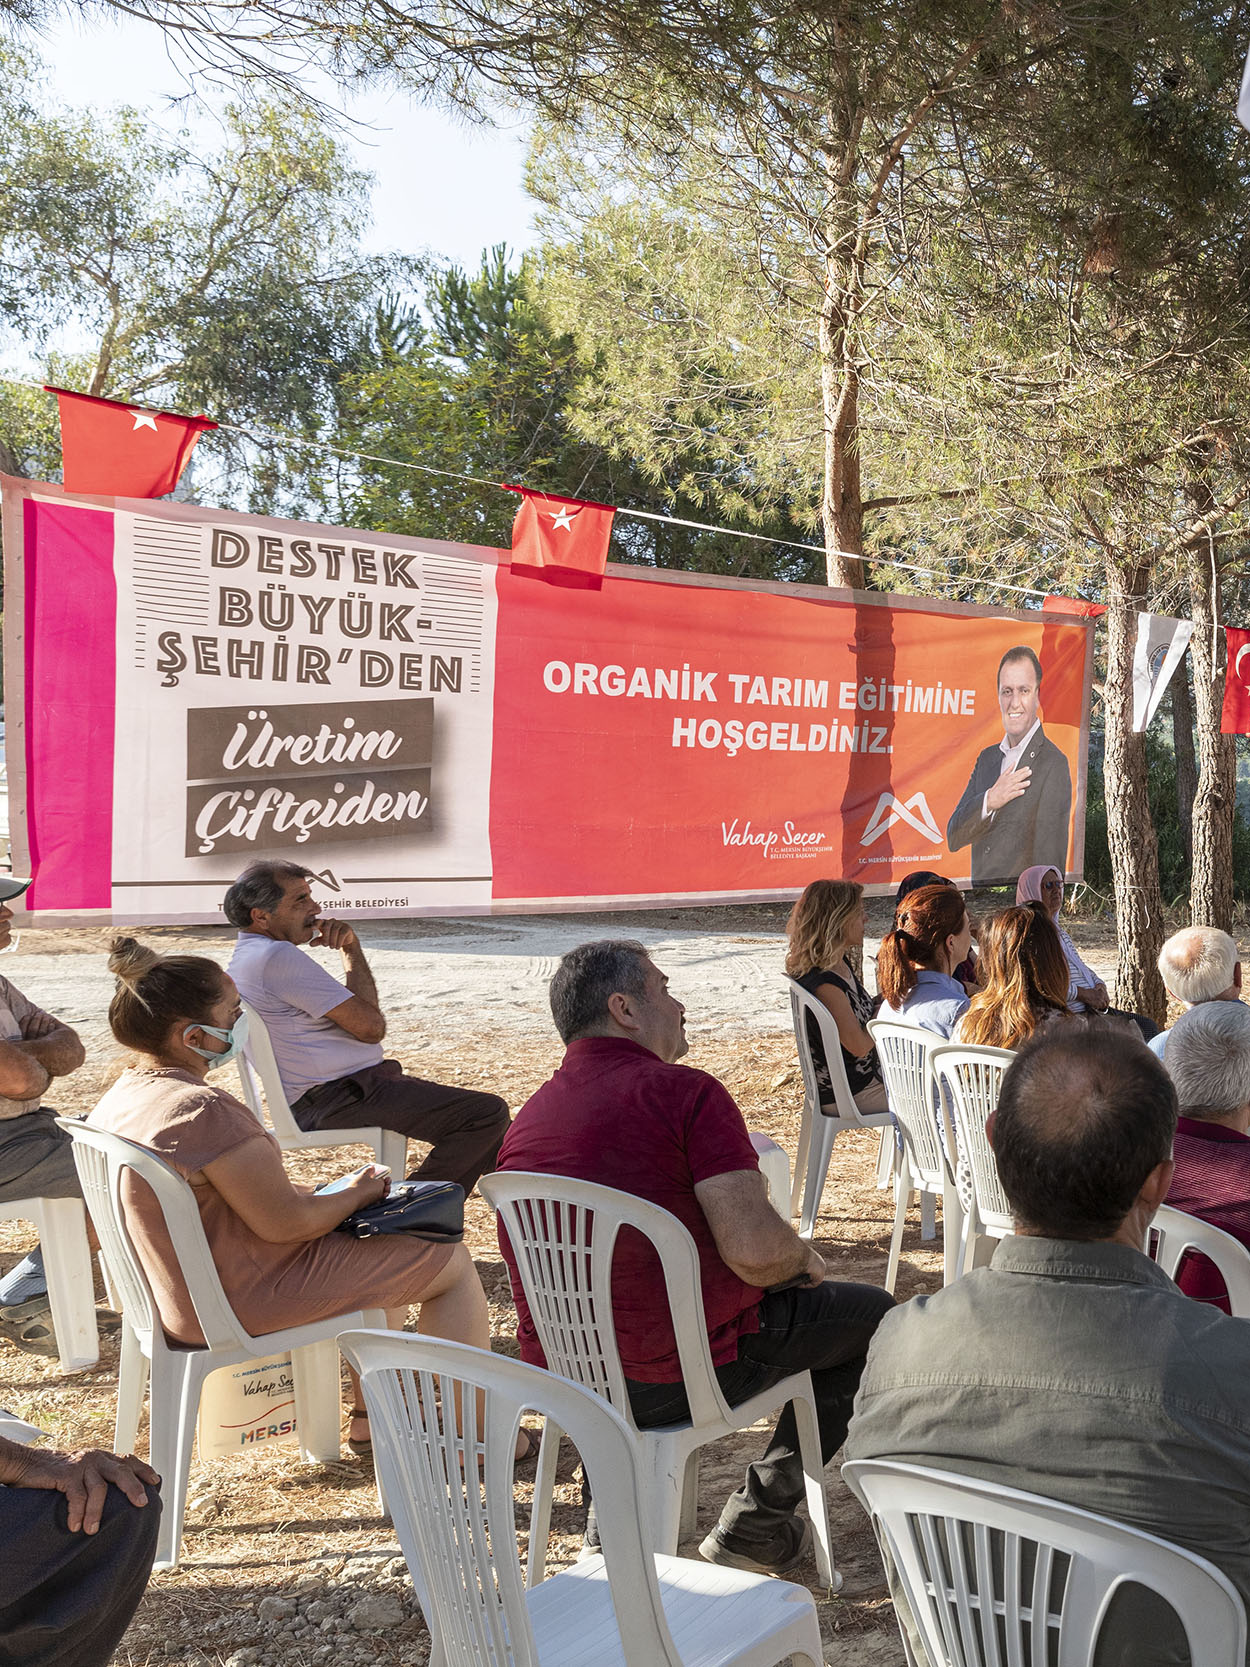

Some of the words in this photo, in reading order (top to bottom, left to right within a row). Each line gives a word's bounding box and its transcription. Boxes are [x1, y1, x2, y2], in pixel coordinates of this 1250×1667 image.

[210, 528, 420, 590] DESTEK
[217, 583, 433, 643] BÜYÜK-
[156, 631, 463, 693] ŞEHİR'DEN
[542, 660, 718, 703] ORGANİK
[727, 674, 829, 709] TARIM
[838, 675, 976, 716] EĞİTİMİNE
[222, 710, 402, 770] Üretim
[671, 717, 894, 757] HOŞGELDİNİZ.
[194, 780, 429, 853] Çiftçiden
[721, 818, 778, 859] Vahap
[782, 820, 826, 846] Seçer
[355, 897, 409, 908] BELEDİYESİ
[243, 1380, 276, 1397] Vahap
[241, 1418, 297, 1445] MERSİ
